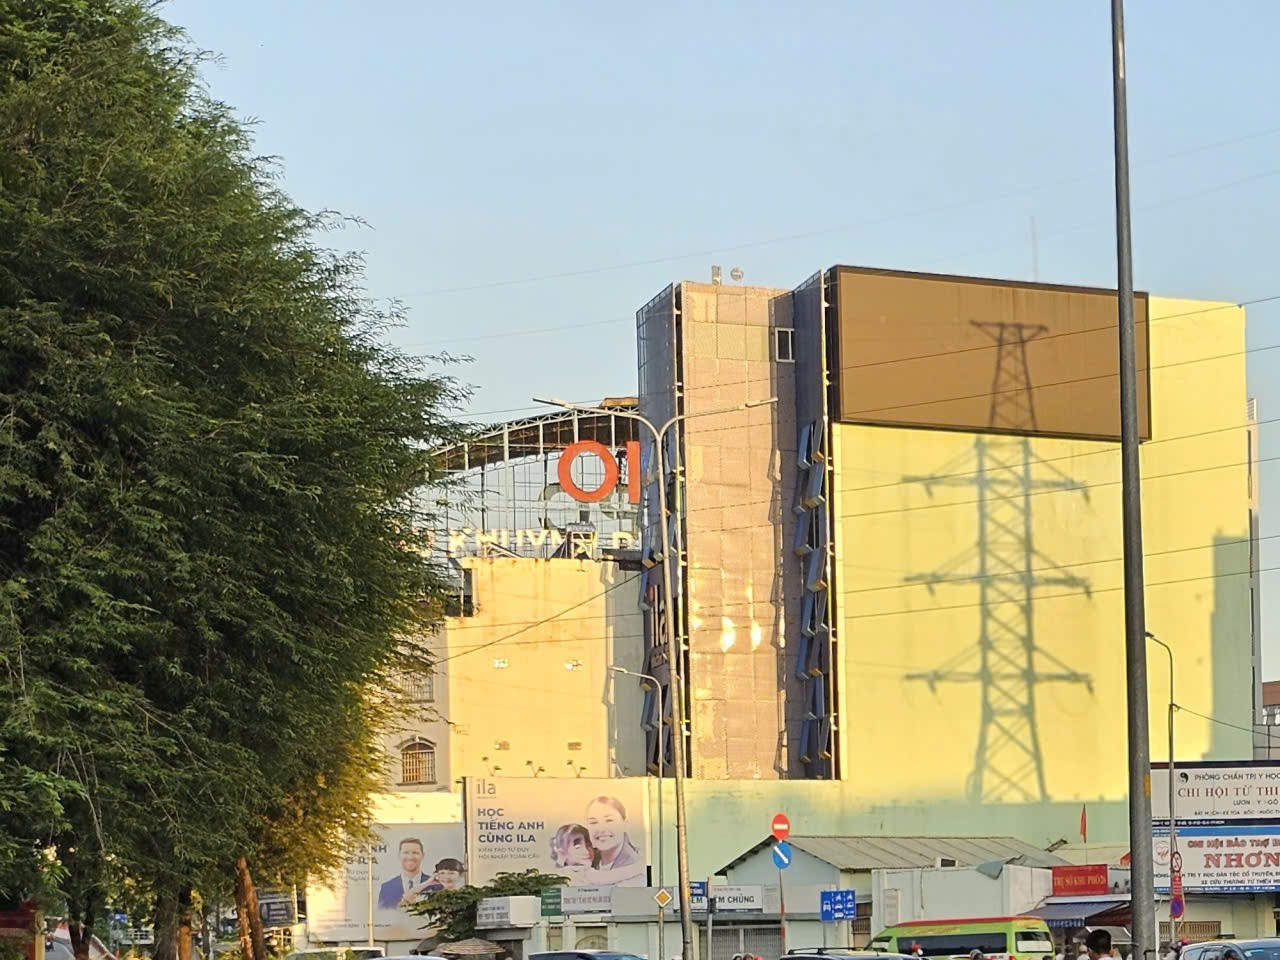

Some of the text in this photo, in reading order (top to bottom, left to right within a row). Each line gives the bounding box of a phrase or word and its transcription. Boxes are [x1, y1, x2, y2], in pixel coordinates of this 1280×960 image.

[477, 779, 496, 795] ila
[1178, 787, 1200, 797] CHI
[1205, 786, 1228, 798] HỘI
[477, 808, 504, 819] HỌC
[478, 818, 545, 830] TIẾNG ANH
[478, 831, 537, 843] CÙNG ILA
[1203, 850, 1280, 868] NHƠN
